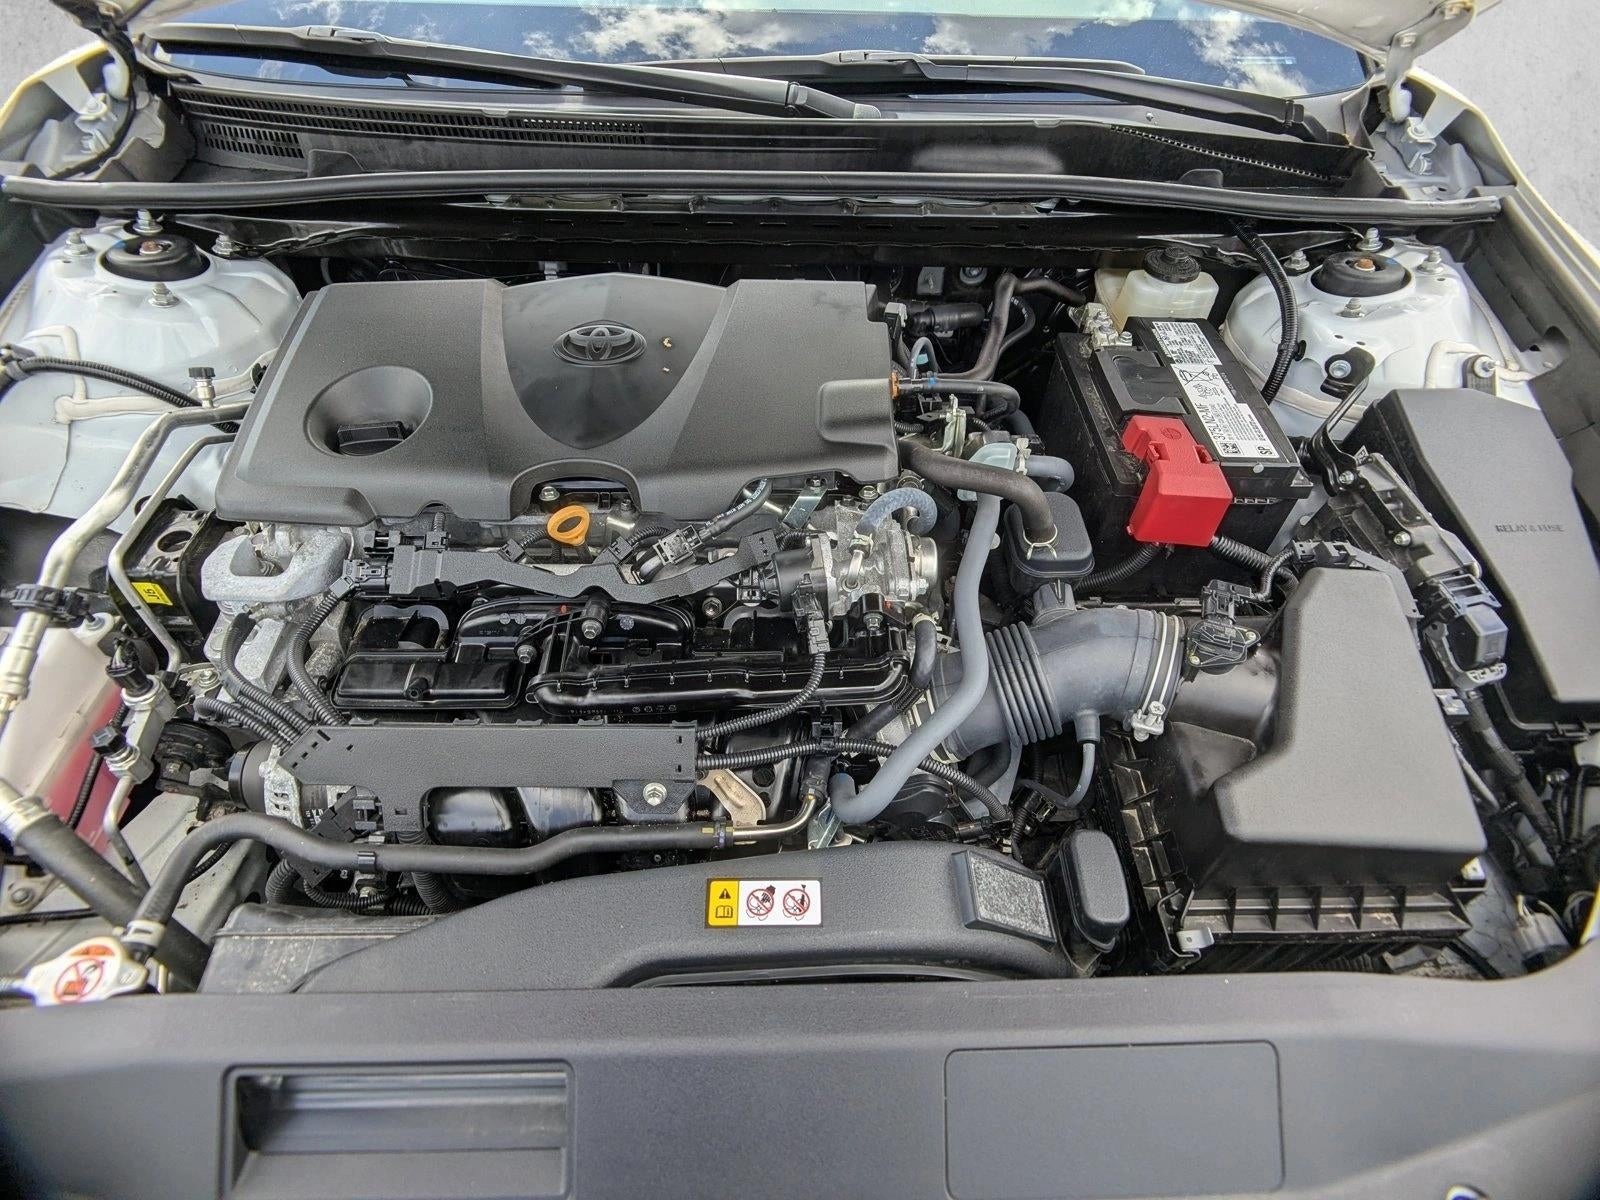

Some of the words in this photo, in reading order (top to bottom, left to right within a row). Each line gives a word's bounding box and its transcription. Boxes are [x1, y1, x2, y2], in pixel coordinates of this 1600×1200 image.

[1257, 445, 1273, 456] SP
[1495, 524, 1527, 533] RELAY
[1537, 524, 1565, 533] FUSE
